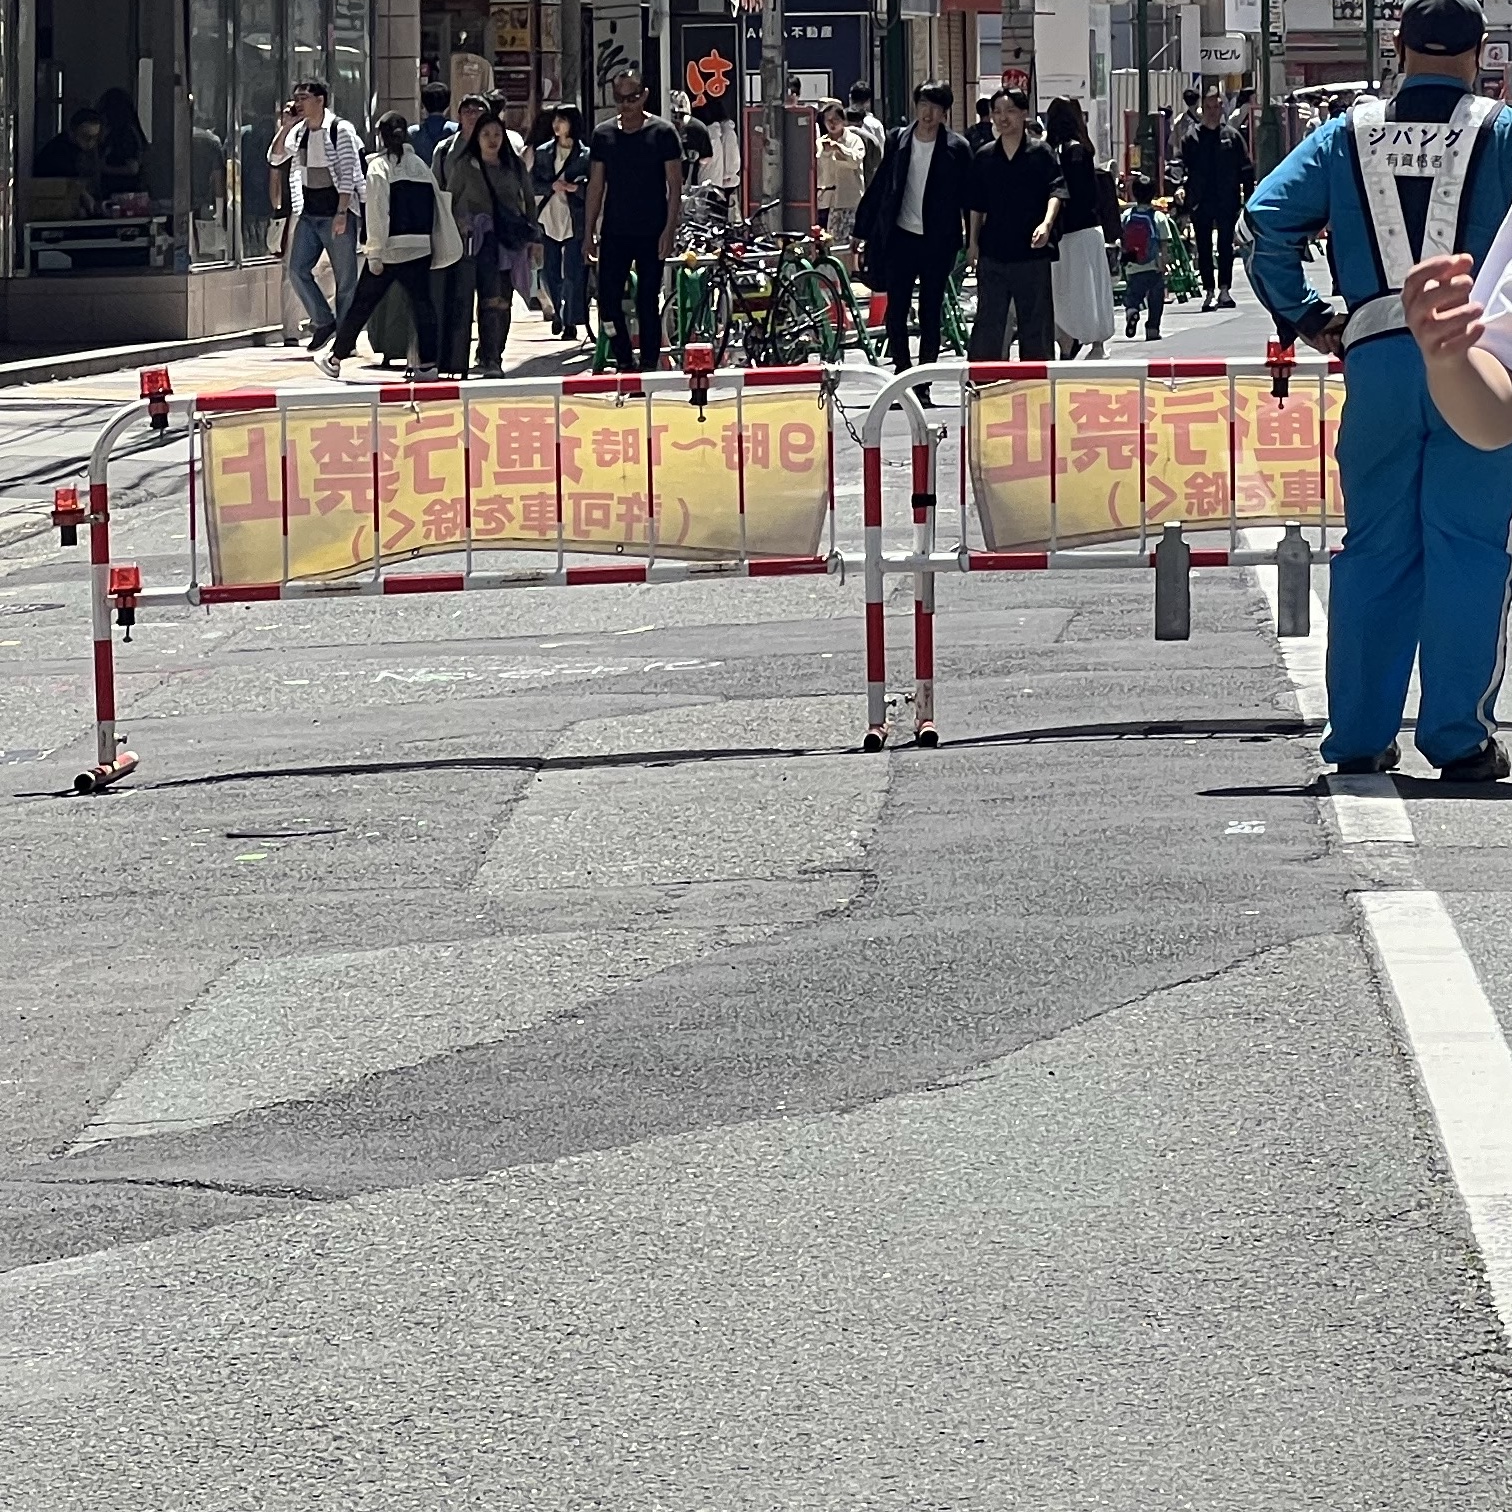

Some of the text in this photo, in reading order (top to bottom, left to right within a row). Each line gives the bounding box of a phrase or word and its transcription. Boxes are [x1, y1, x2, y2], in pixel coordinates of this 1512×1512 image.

[791, 26, 833, 38] 不動産
[1368, 126, 1464, 148] ジパング
[1386, 153, 1444, 169] 有資格者
